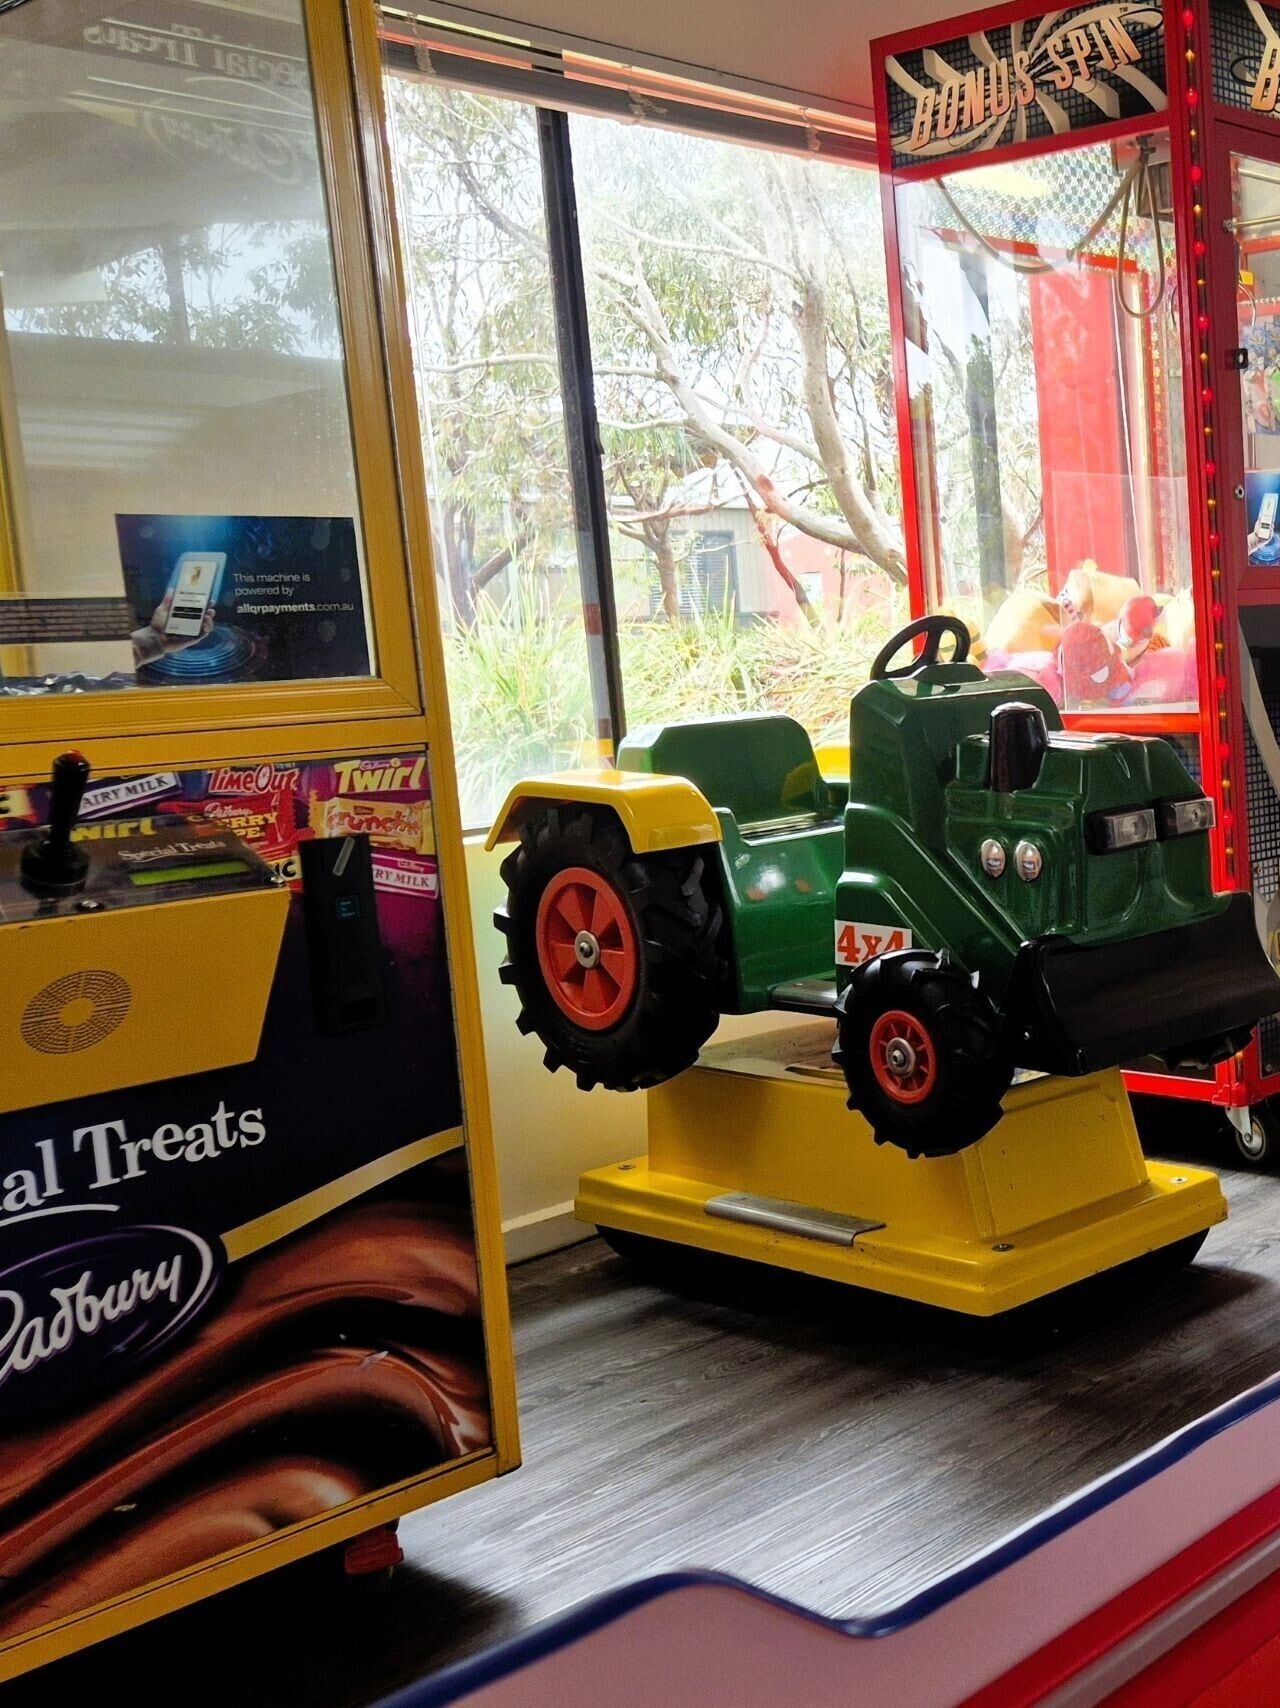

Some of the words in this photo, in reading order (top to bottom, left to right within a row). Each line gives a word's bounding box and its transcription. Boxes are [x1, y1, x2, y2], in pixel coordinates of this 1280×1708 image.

[909, 49, 1036, 152] BONUS
[1047, 14, 1143, 91] SPIN
[232, 573, 255, 583] This
[256, 573, 301, 583] machine
[302, 572, 311, 582] is
[234, 586, 280, 597] powered
[281, 586, 295, 597] by
[333, 756, 427, 794] Twirl
[82, 788, 123, 809] AIRY
[125, 775, 170, 797] MILK
[68, 816, 158, 843] wirl
[117, 844, 177, 862] Special
[174, 840, 227, 853] Treats
[374, 870, 393, 881] RY
[393, 871, 430, 888] MILK
[0, 1138, 65, 1213] al
[73, 1100, 266, 1190] Treats
